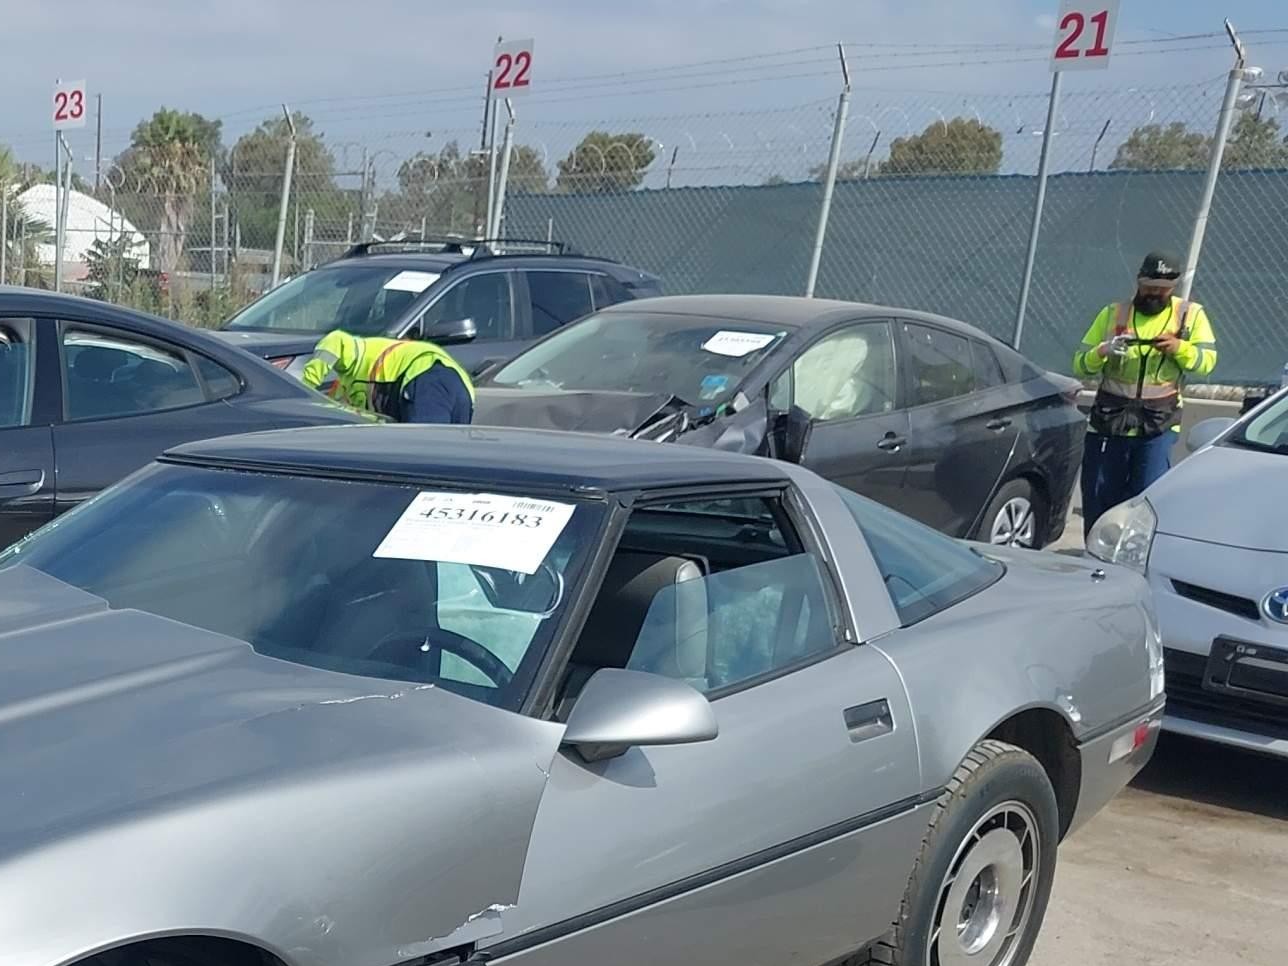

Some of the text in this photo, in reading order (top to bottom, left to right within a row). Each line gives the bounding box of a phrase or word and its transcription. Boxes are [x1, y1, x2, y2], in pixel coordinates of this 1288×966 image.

[1055, 10, 1108, 58] 21
[495, 51, 531, 88] 22
[55, 90, 83, 120] 23
[420, 506, 543, 529] 45316183
